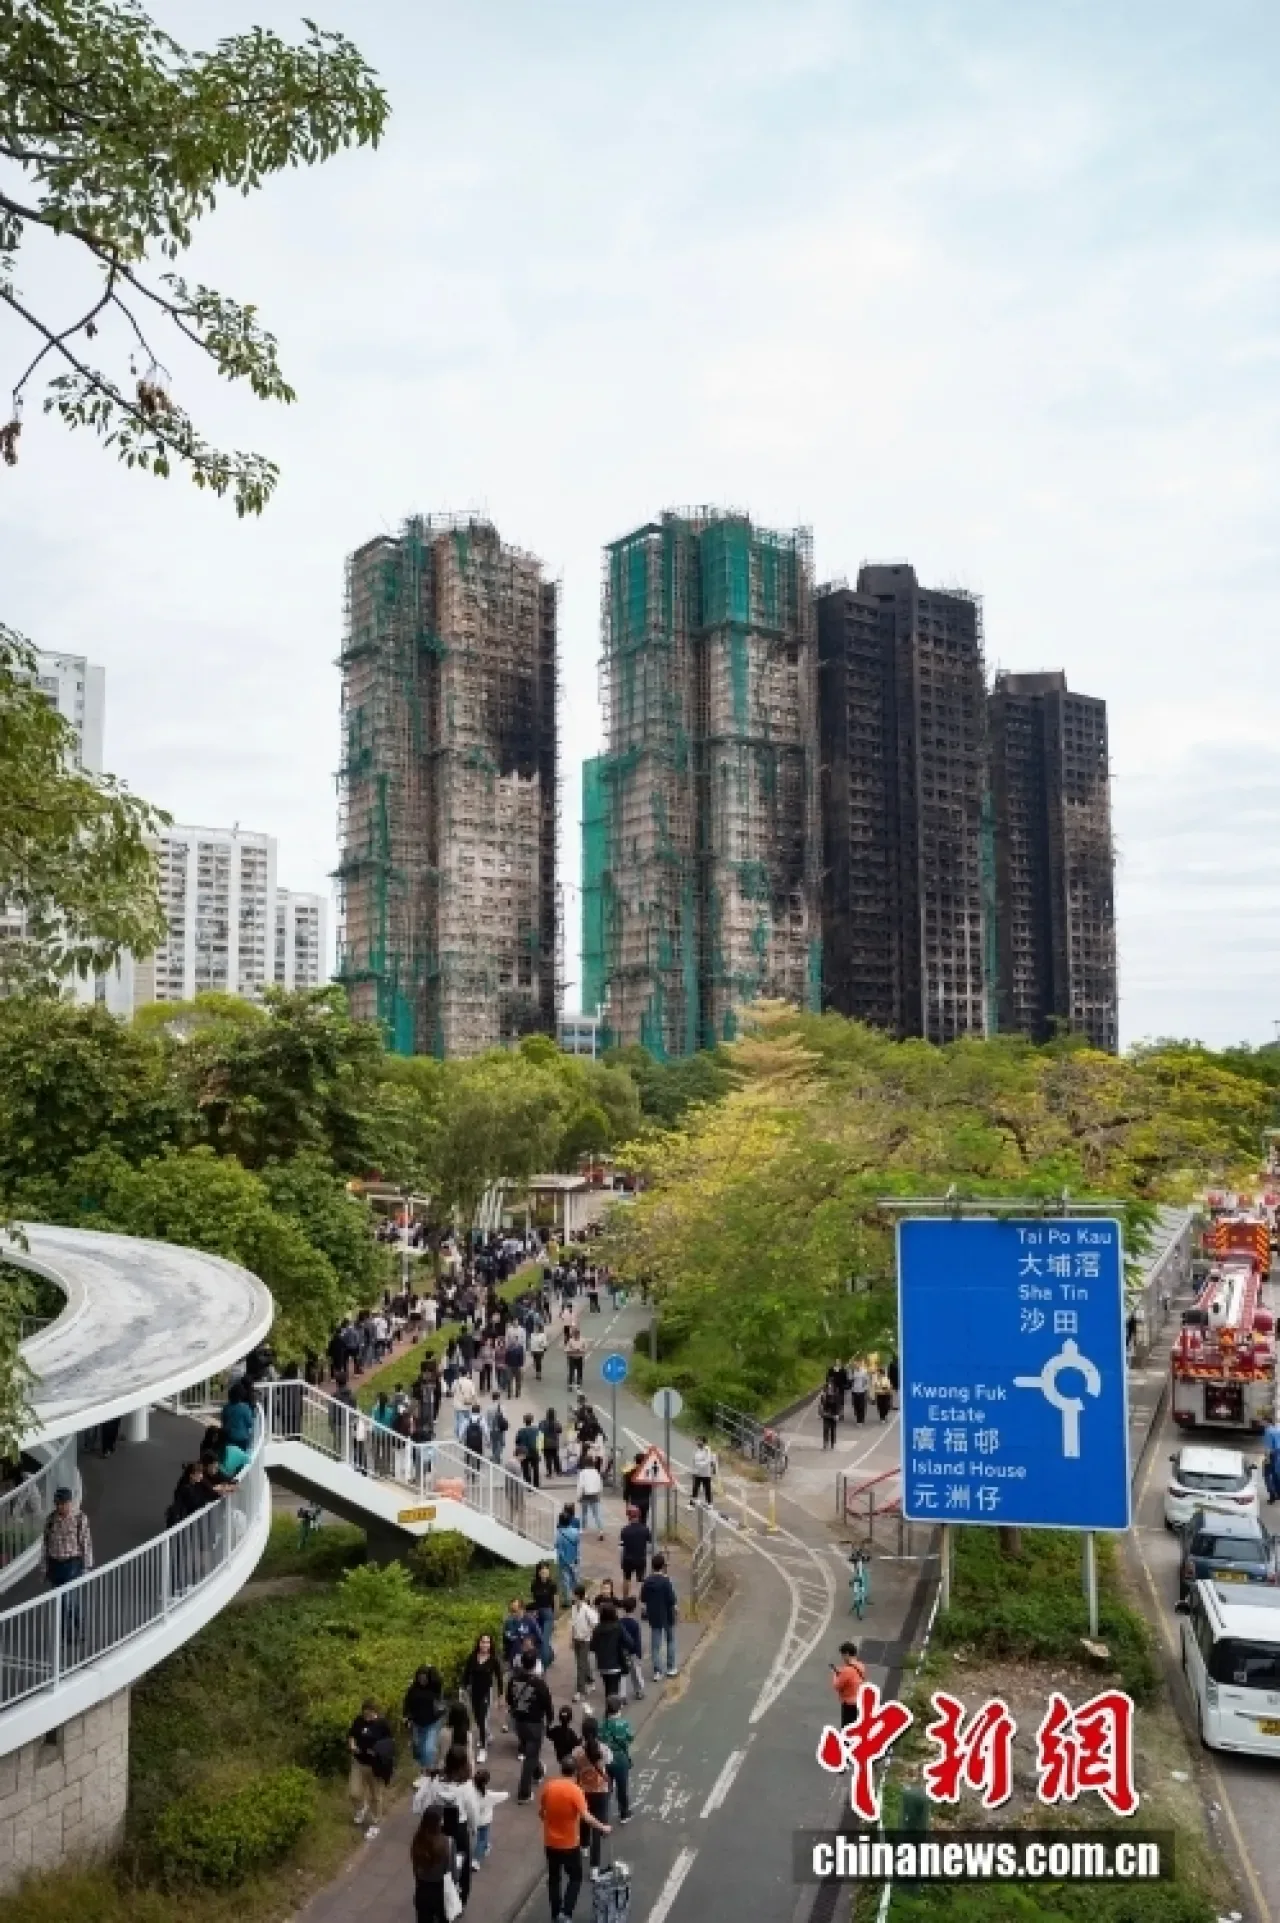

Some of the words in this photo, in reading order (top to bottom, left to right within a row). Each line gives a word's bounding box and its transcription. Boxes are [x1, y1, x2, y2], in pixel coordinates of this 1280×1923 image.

[1016, 1227, 1042, 1245] Tai
[1049, 1227, 1070, 1245] Po
[1077, 1227, 1112, 1245] Kau
[1018, 1284, 1052, 1300] Sha
[1059, 1284, 1088, 1300] Tin
[1020, 1307, 1078, 1334] 沙田
[912, 1382, 970, 1403] Kwong
[975, 1384, 1006, 1401] Fuk
[928, 1405, 985, 1423] Estate
[912, 1459, 965, 1475] Island
[970, 1461, 1027, 1479] House
[913, 1482, 1002, 1510] 元洲仔
